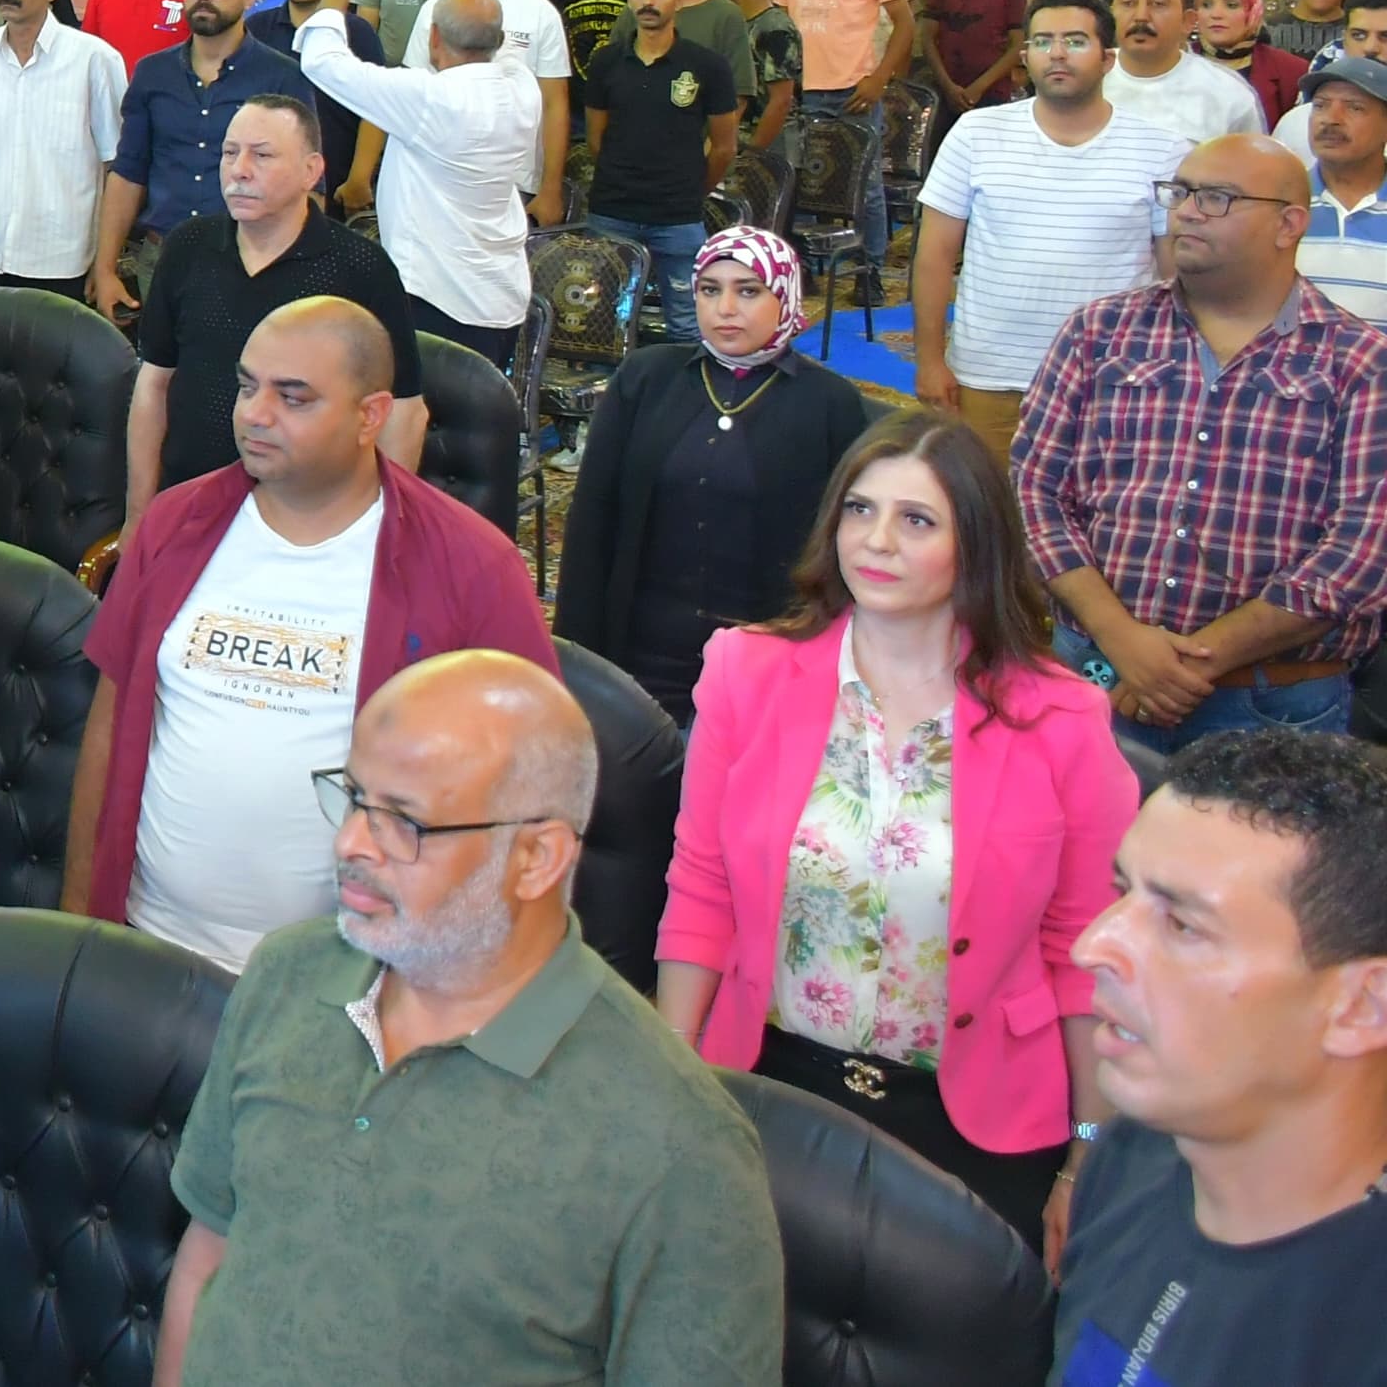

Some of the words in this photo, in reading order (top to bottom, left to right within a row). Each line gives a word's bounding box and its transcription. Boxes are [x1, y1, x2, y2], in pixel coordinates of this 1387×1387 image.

[205, 629, 324, 673] BREAK
[223, 679, 295, 699] IGNORAN
[1152, 1280, 1187, 1325] BIRIS
